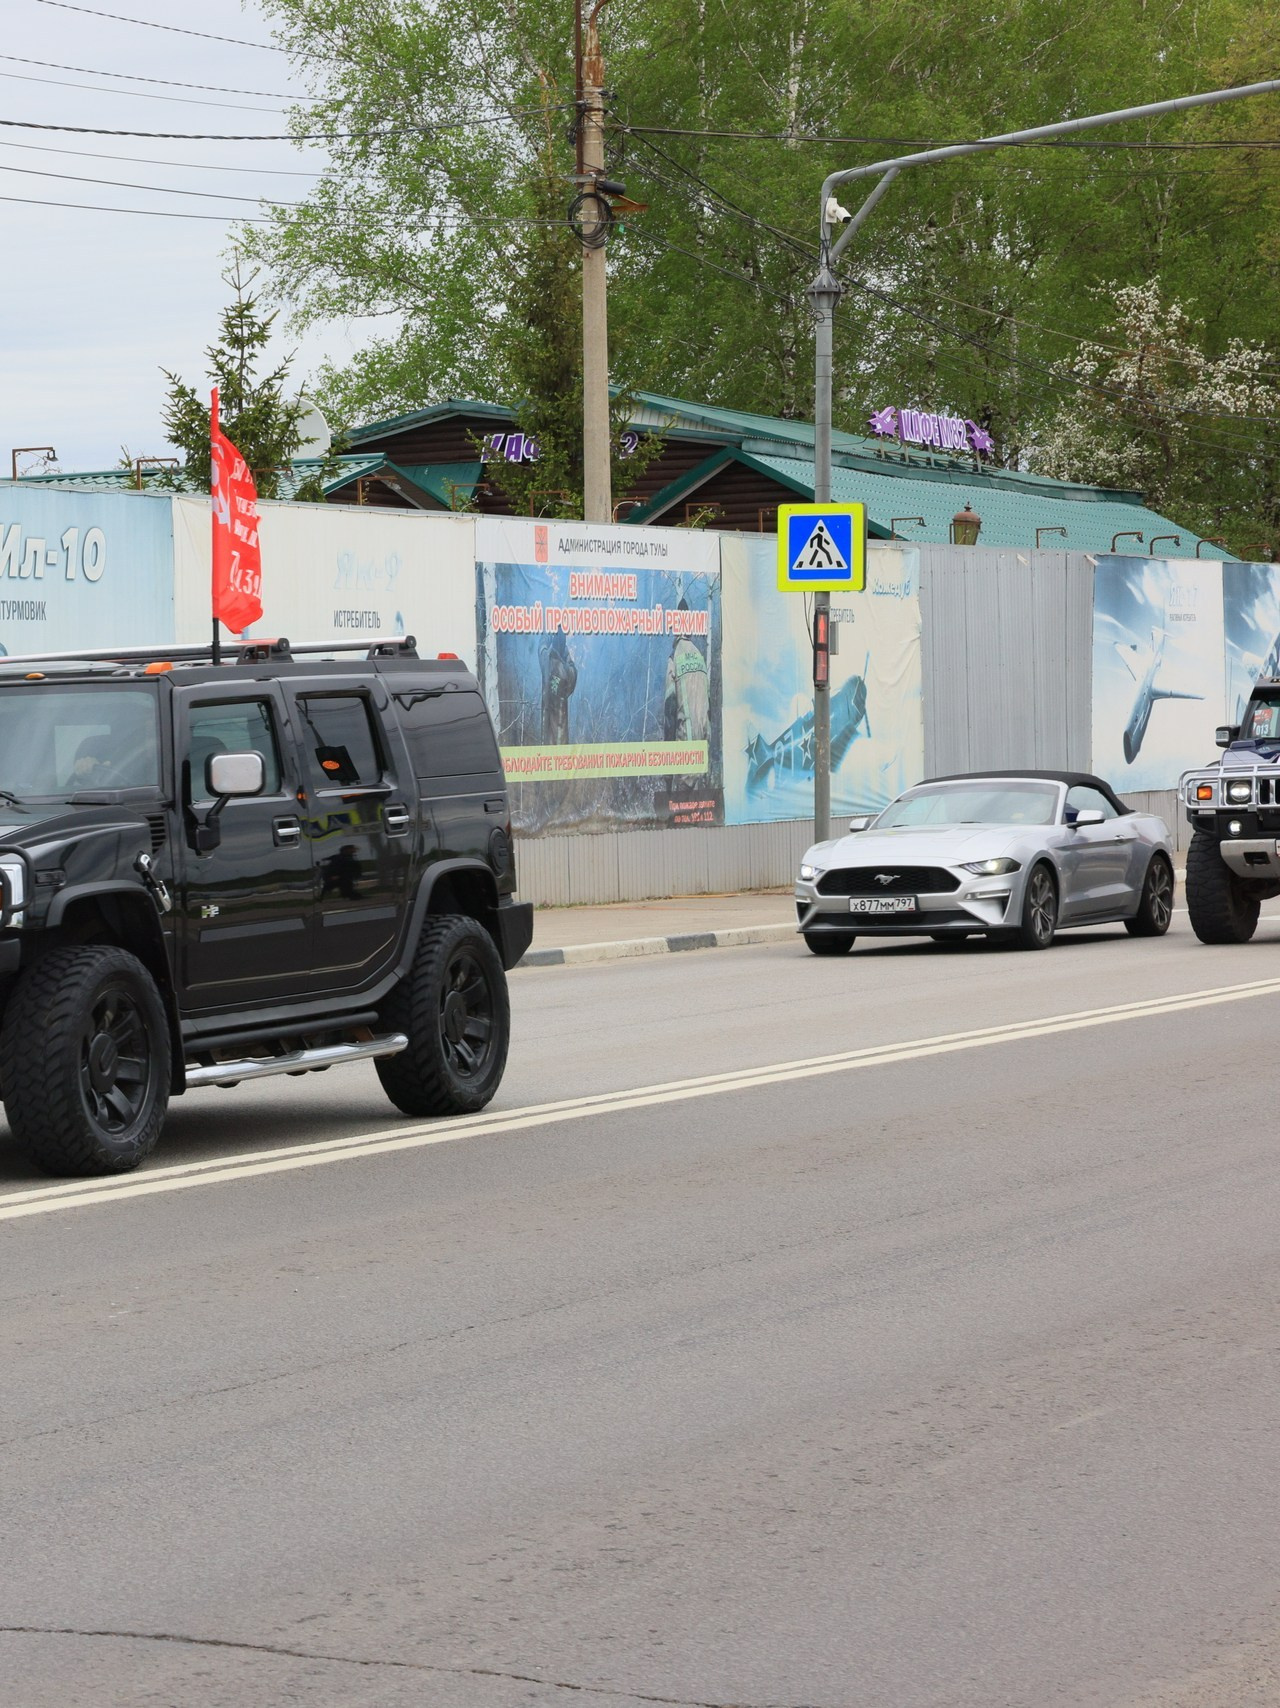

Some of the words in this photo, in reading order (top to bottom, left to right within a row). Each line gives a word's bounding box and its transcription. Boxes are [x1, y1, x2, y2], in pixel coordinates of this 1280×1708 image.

[901, 409, 940, 446] КАФЕ
[558, 538, 621, 556] АДМИНИСТРАЦИЯ
[623, 541, 648, 556] ГОРОДА
[650, 543, 668, 557] ТУЛЫ
[570, 572, 638, 599] ВНИМАНИЕ!
[333, 610, 381, 629] ИСТРЕБИТЕЛЬ
[491, 602, 544, 633] ОСОБЫЙ
[545, 604, 664, 634] ПРОТИВОПОЖАРНЫЙ
[665, 609, 709, 635] РЕЖИМ!
[553, 755, 604, 771] ТРЕБОВАНИЯ
[605, 749, 647, 768] ПОЖАРНОЙ
[648, 750, 705, 766] БЕЗОПАСНОСТИ!
[895, 898, 912, 907] 797
